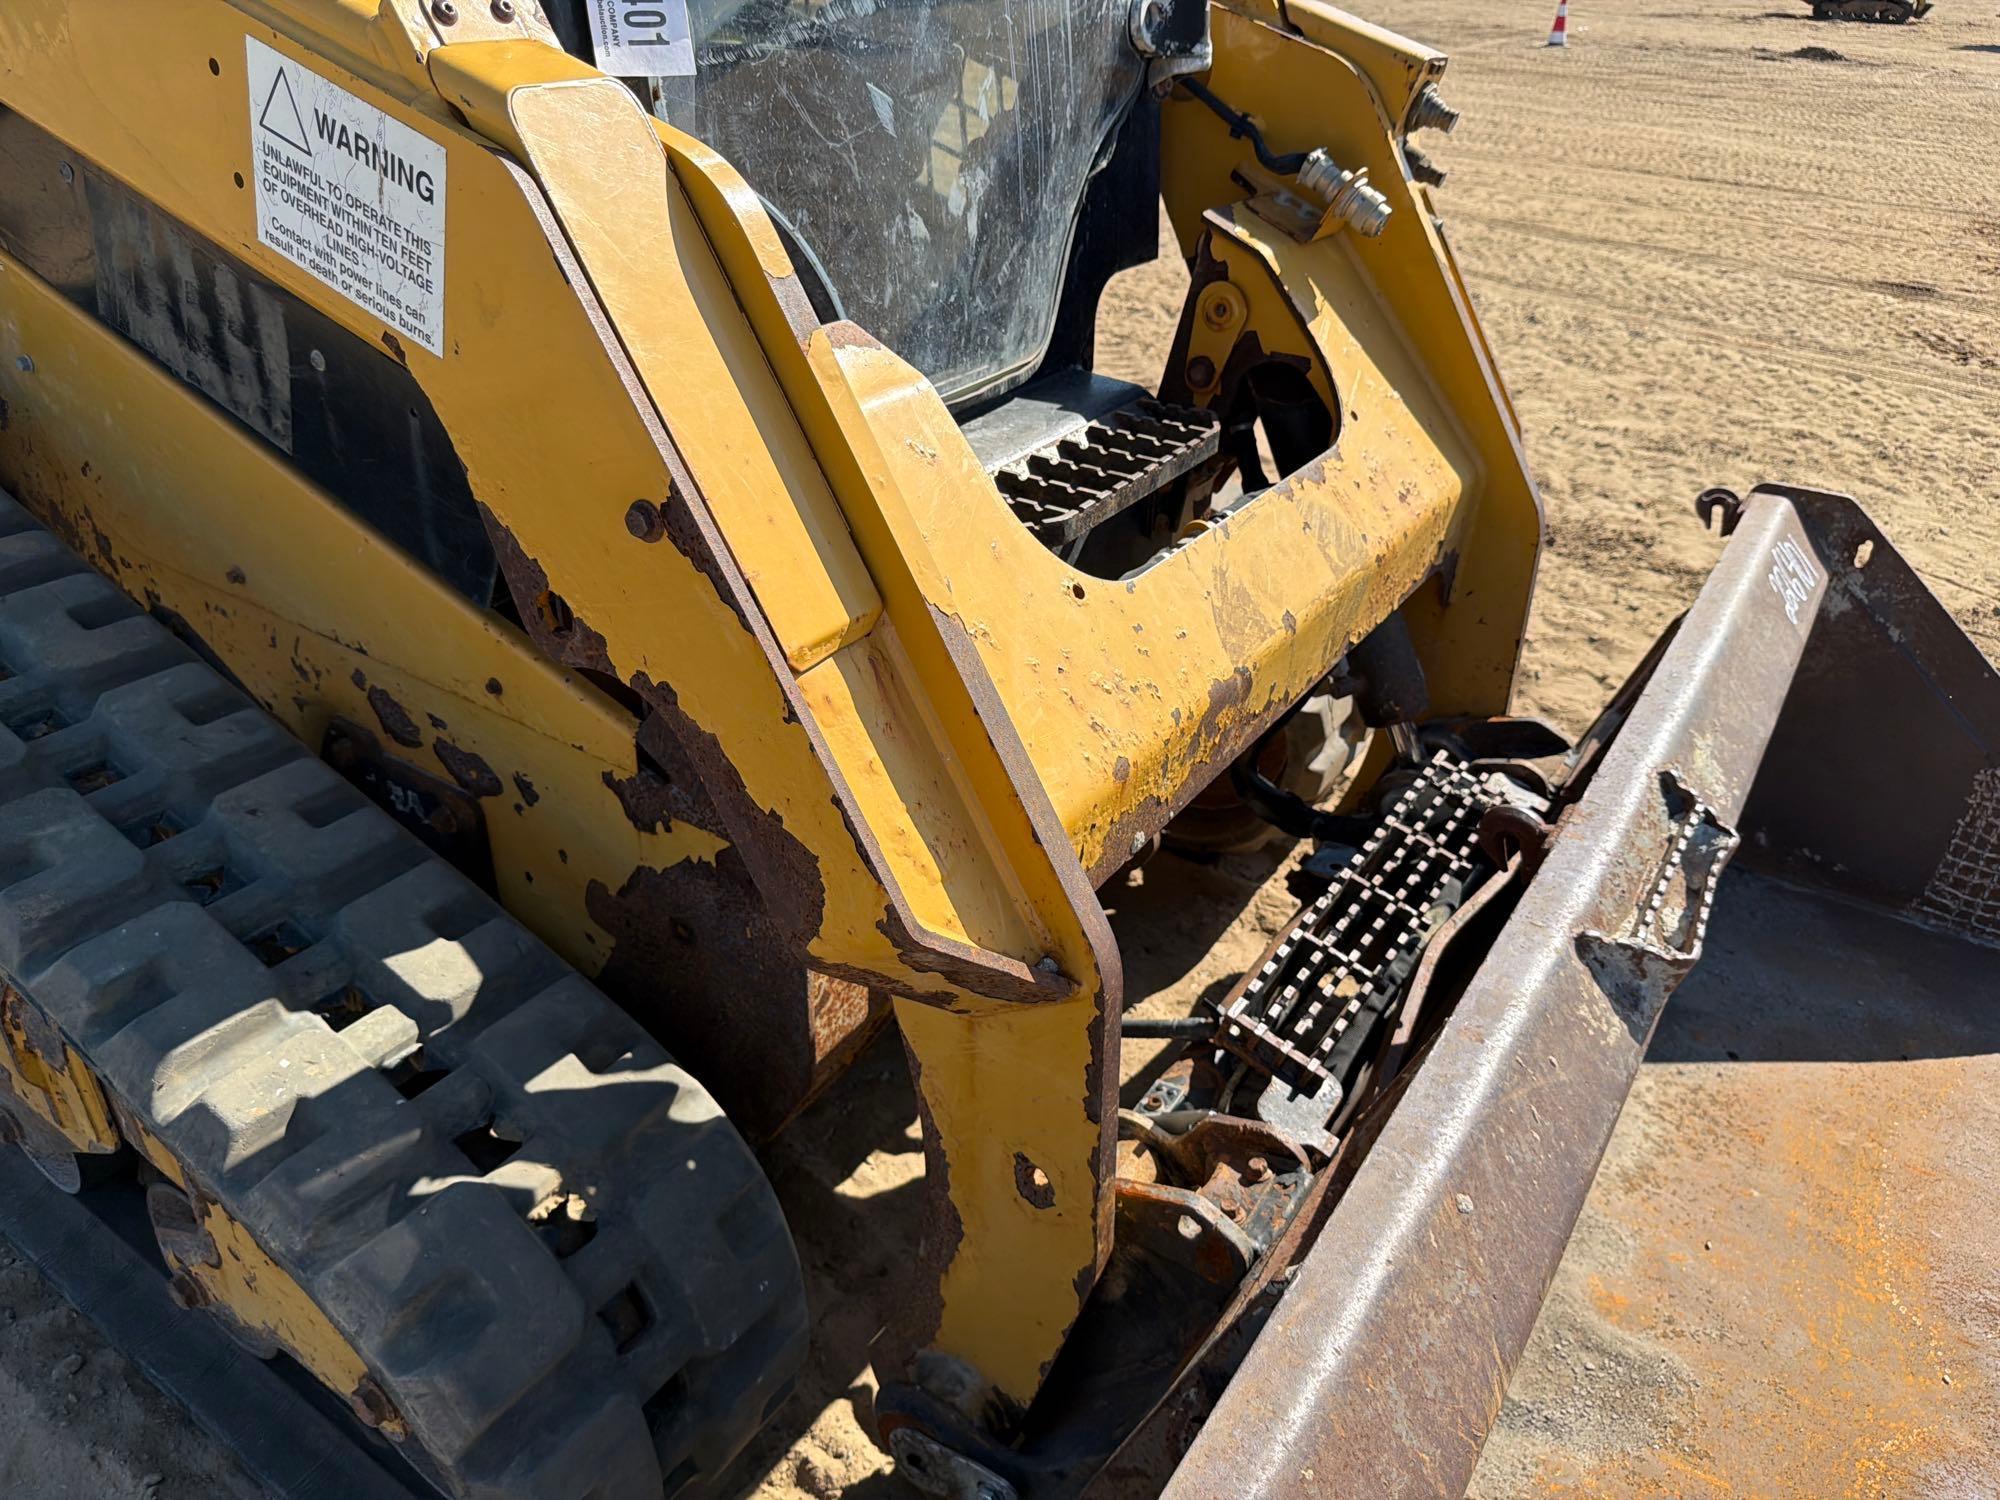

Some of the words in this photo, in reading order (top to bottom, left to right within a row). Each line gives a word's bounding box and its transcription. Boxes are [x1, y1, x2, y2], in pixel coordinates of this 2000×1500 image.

[606, 0, 621, 48] COMPANY
[262, 140, 326, 192] UNLAWFUL
[326, 179, 343, 201] TO
[345, 192, 402, 239] OPERATE
[403, 227, 432, 256] THIS
[313, 107, 434, 206] WARNING
[262, 177, 278, 195] OF
[280, 188, 343, 238] OVERHEAD
[346, 229, 433, 295] HIGH-VOLTAGE
[263, 159, 330, 211] EQUIPMENT
[330, 201, 372, 239] WITHIN
[374, 228, 398, 255] TEN
[401, 244, 432, 275] FEET
[271, 216, 312, 253] Contact
[314, 245, 337, 268] with
[339, 262, 373, 290] power
[375, 282, 402, 310] lines
[405, 304, 426, 325] can
[325, 233, 360, 266] LINES
[265, 229, 295, 257] result
[296, 247, 306, 264] in
[308, 258, 339, 285] death
[341, 279, 353, 293] or
[355, 288, 396, 322] serious
[399, 313, 435, 347] burns.
